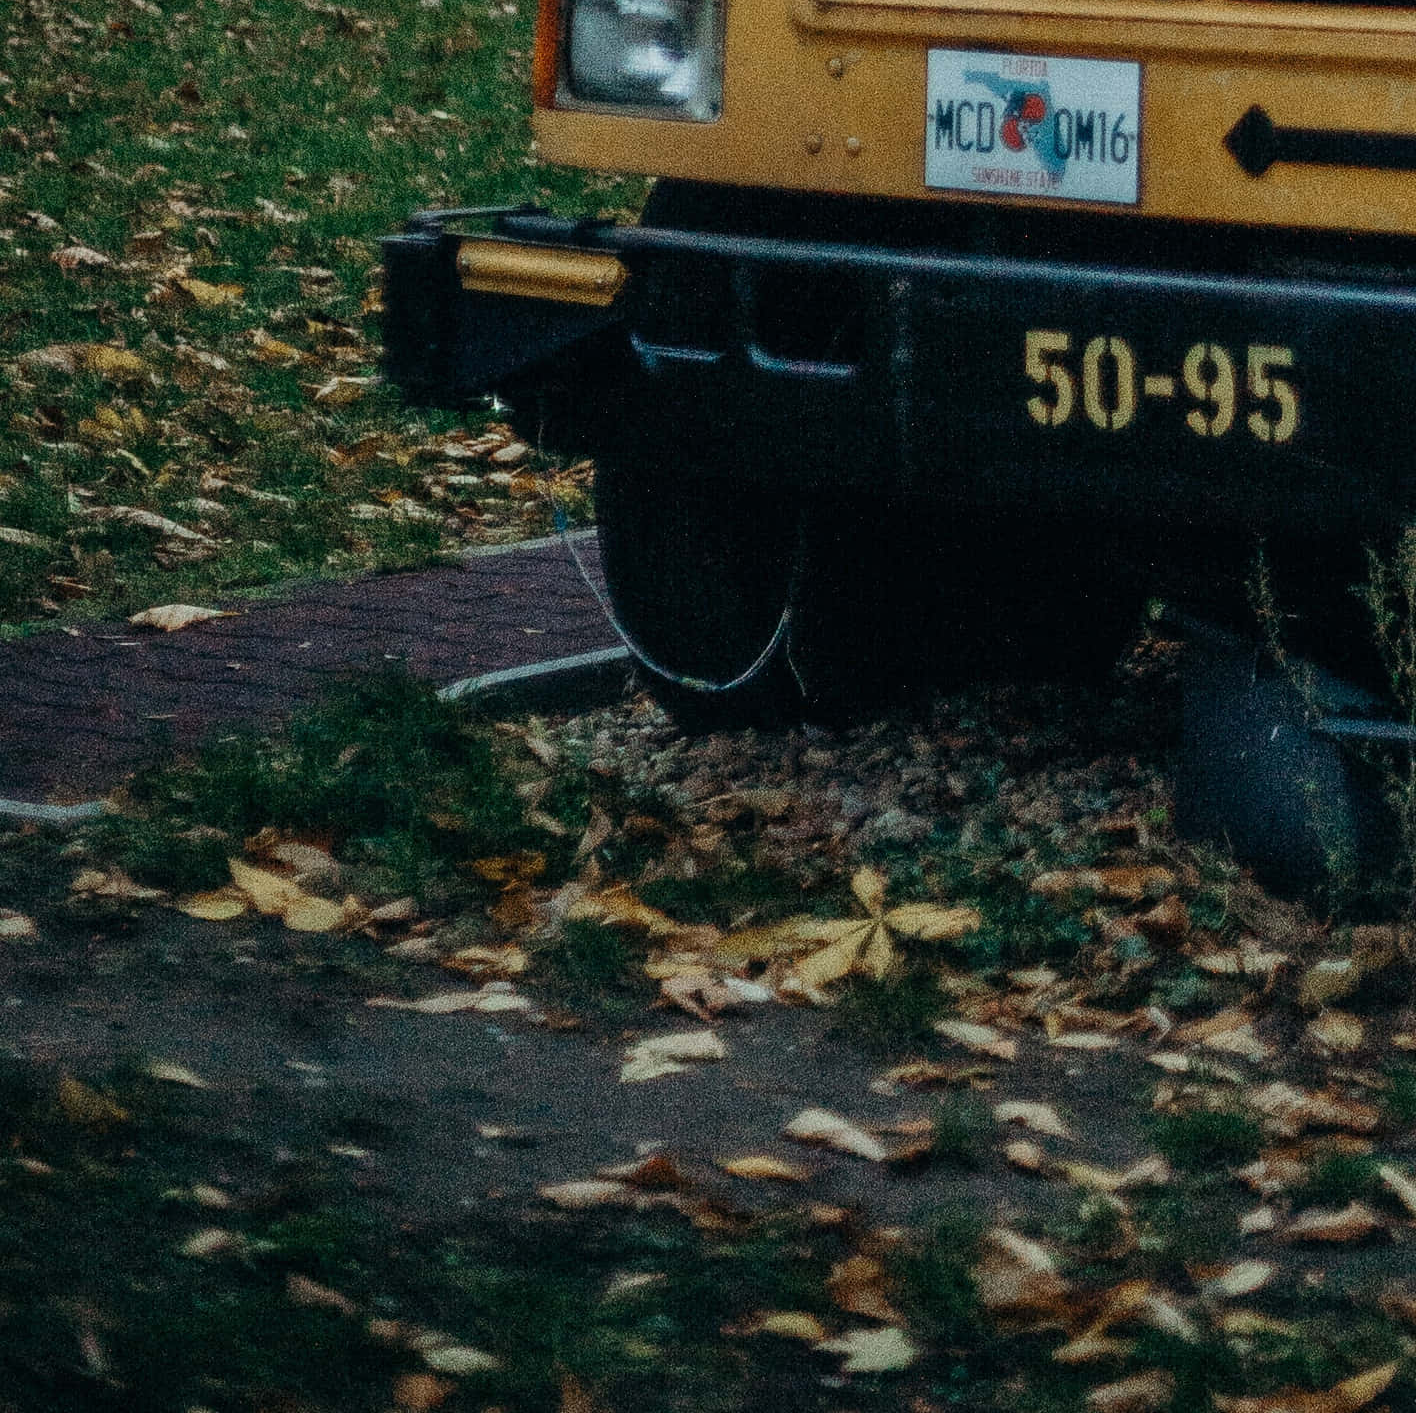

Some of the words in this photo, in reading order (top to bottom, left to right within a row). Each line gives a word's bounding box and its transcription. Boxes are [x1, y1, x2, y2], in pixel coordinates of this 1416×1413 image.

[1001, 58, 1048, 77] FLORIDA
[934, 99, 995, 153] MCD
[1025, 329, 1302, 443] 50-95
